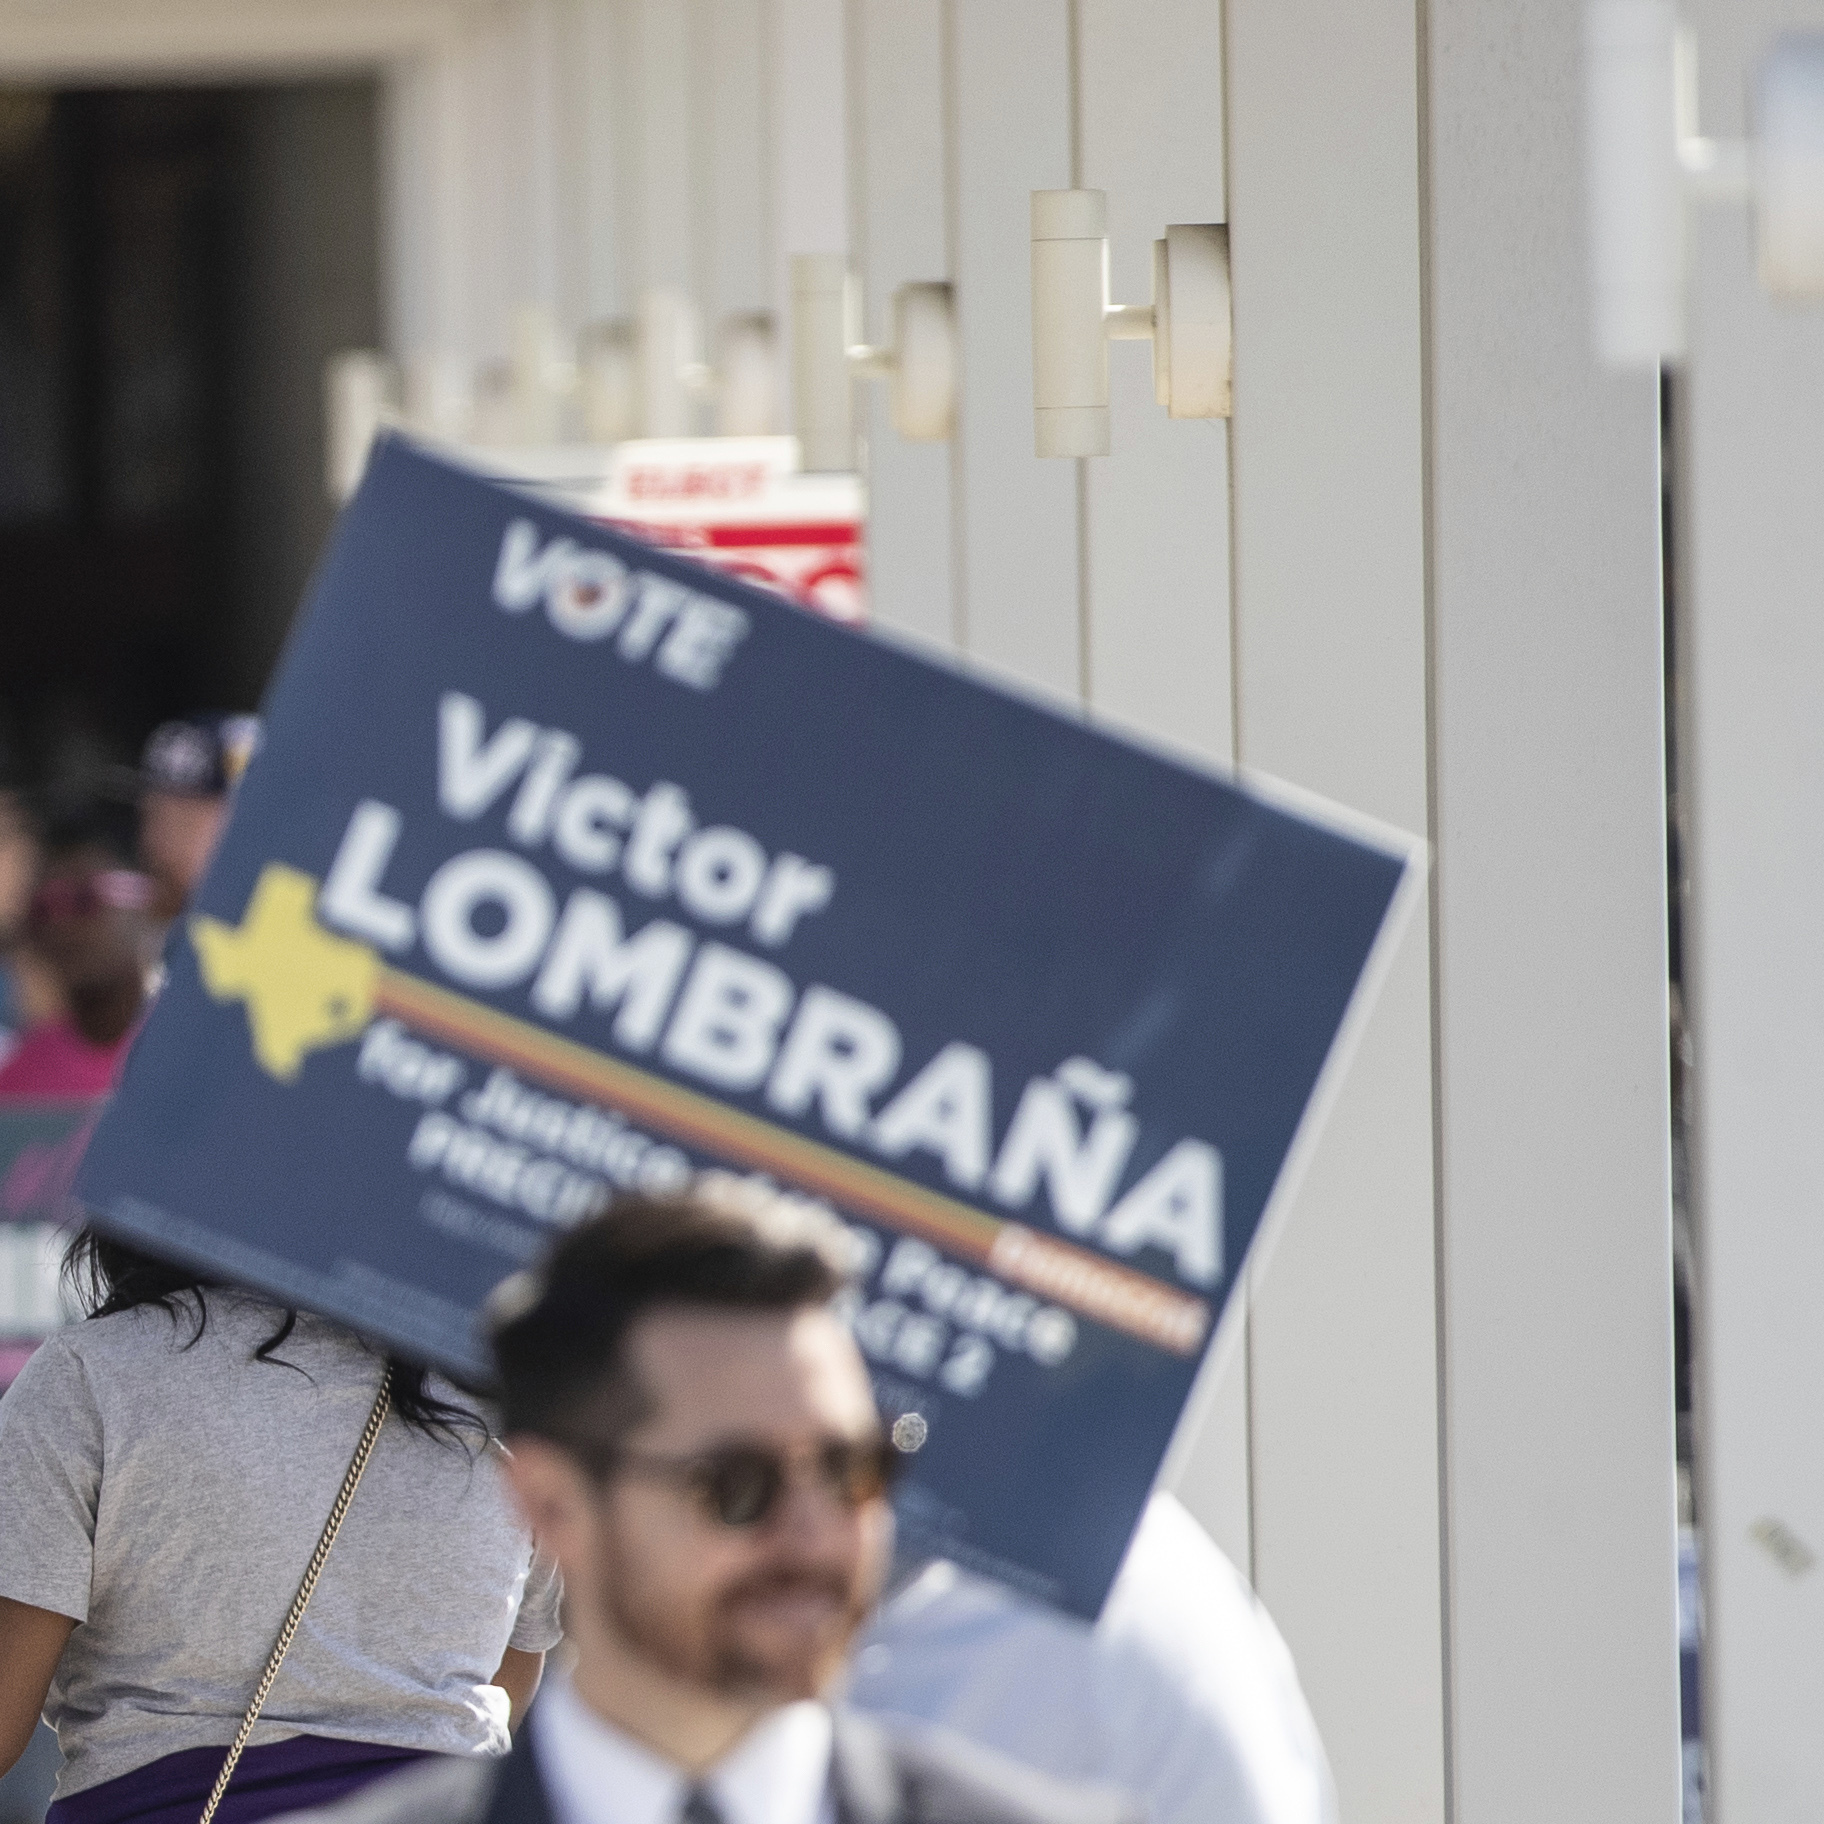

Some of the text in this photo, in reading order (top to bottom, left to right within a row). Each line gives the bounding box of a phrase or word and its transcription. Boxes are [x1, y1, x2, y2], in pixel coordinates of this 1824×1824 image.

[491, 516, 751, 694] VOTE
[435, 690, 836, 948] Victor
[318, 800, 1229, 1286] LOMBRAÑA
[357, 1018, 466, 1104] for
[881, 1236, 1078, 1368] Peace
